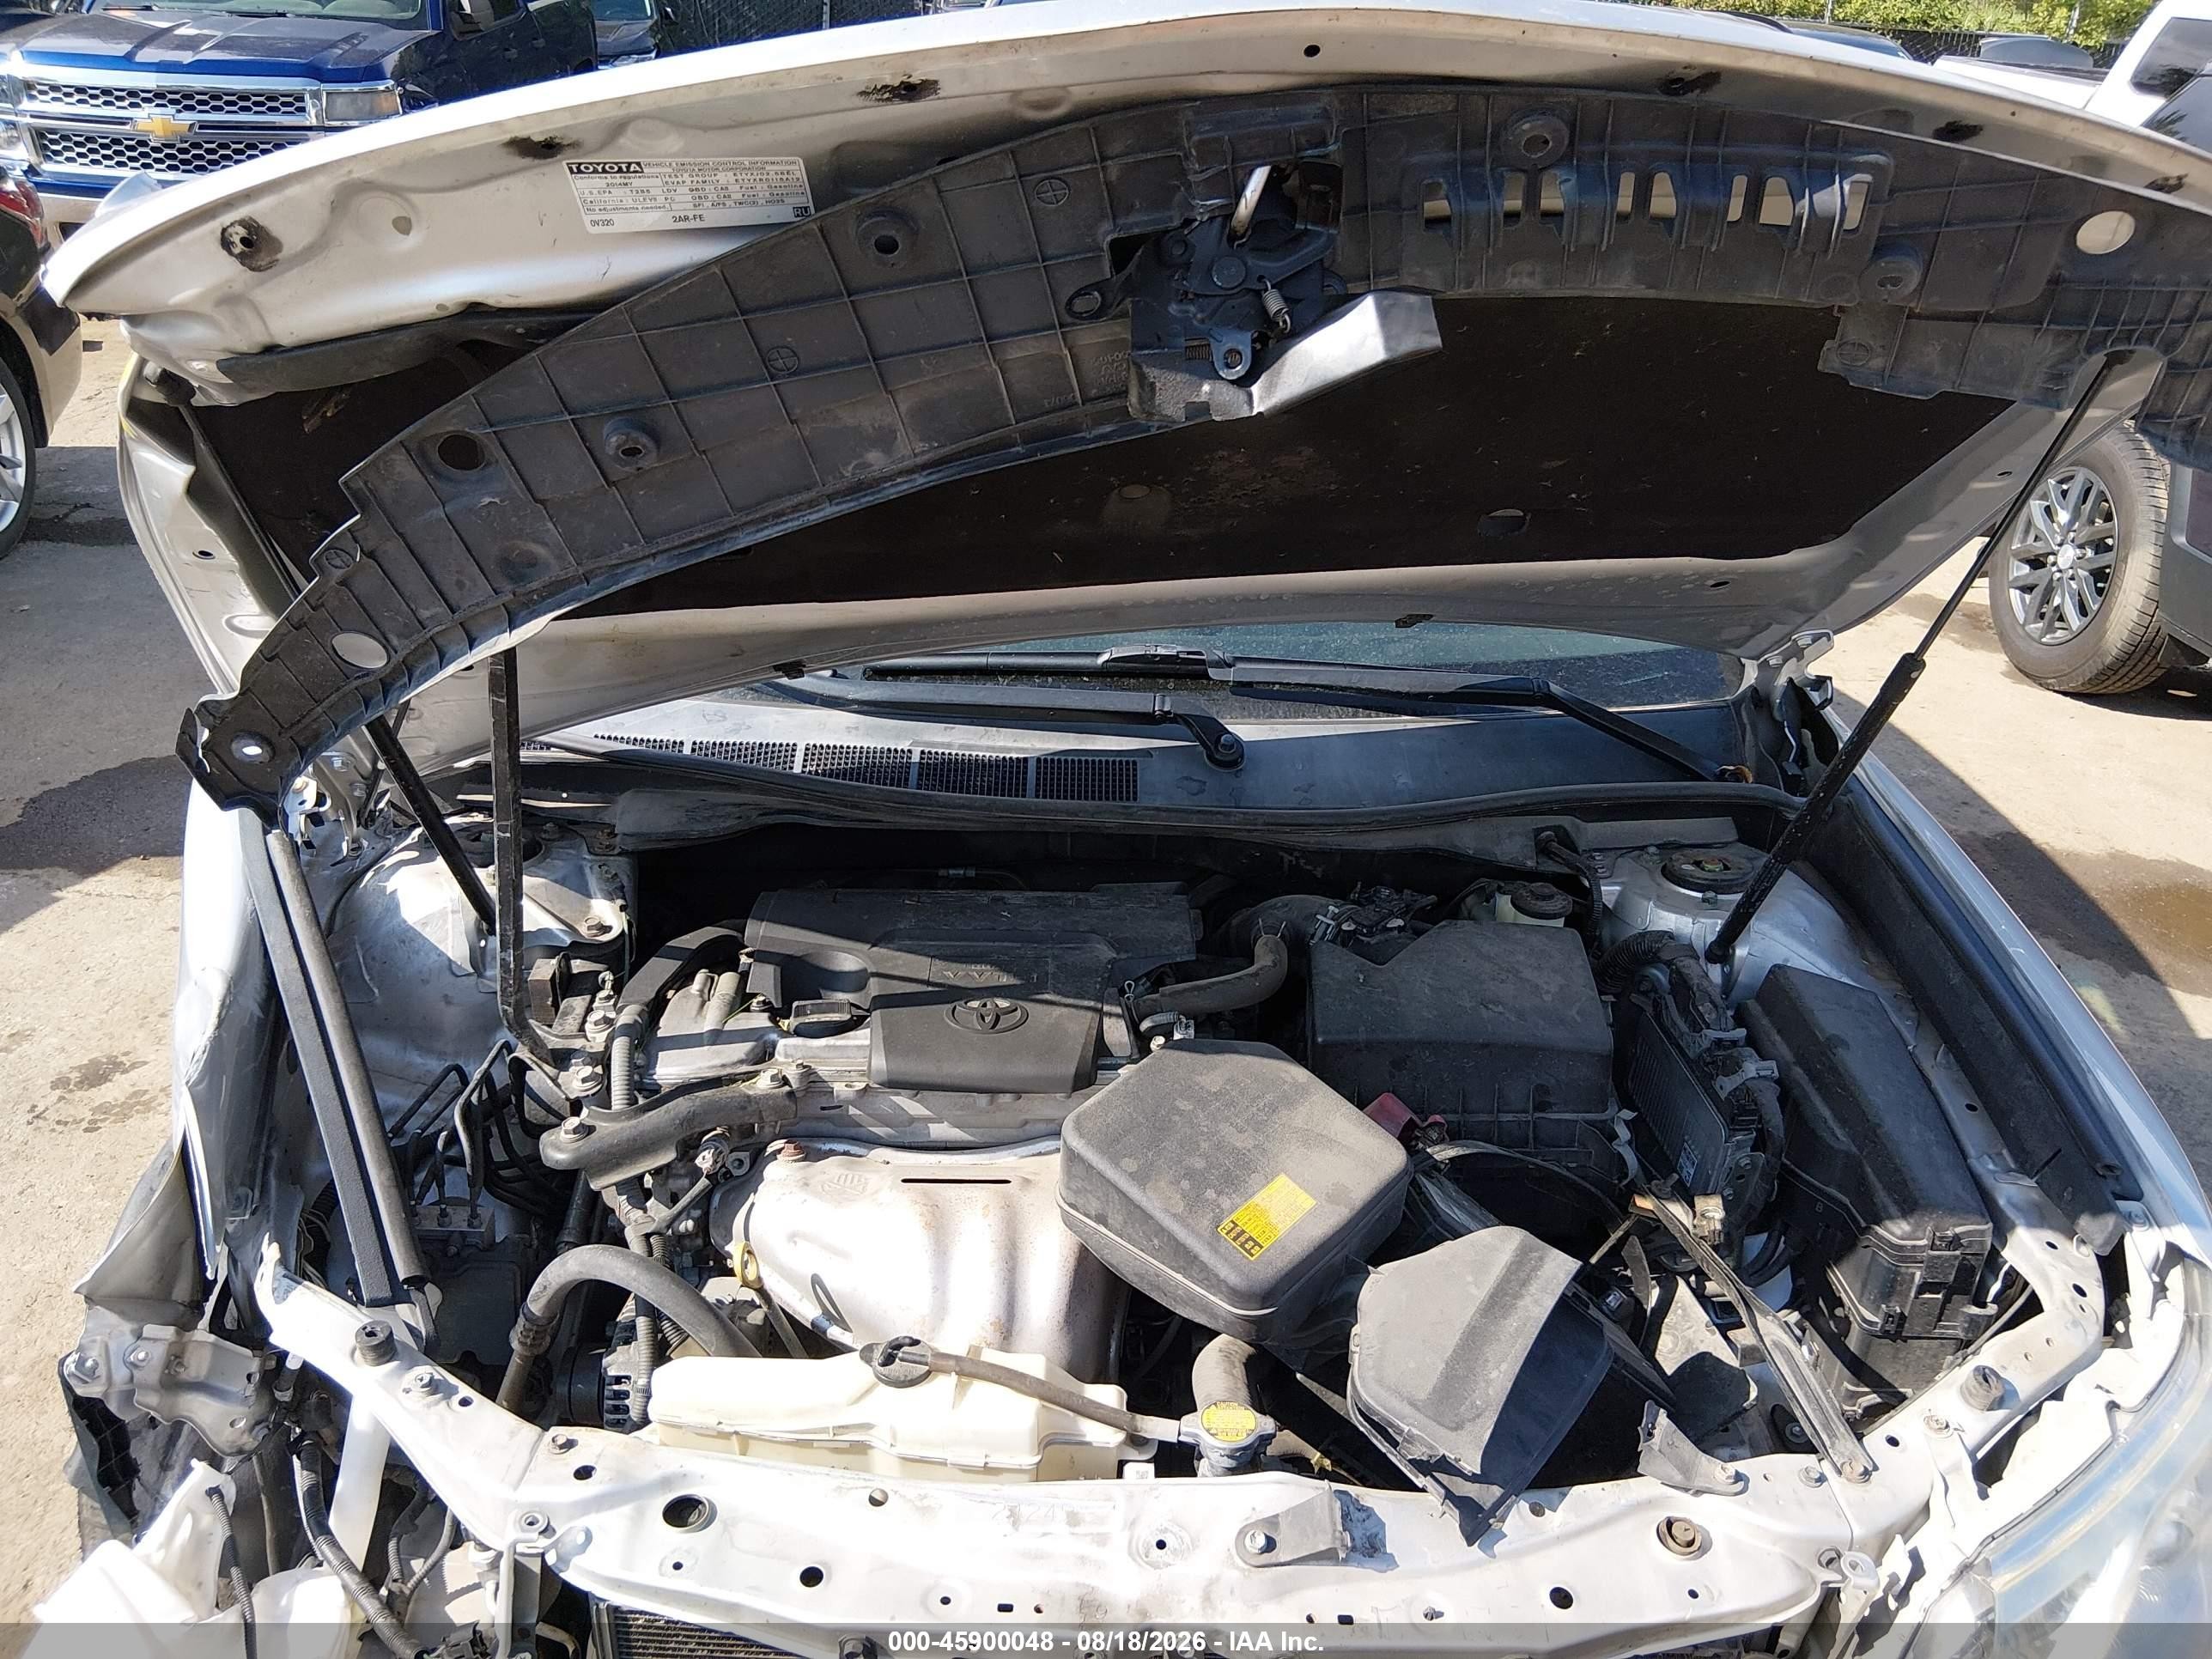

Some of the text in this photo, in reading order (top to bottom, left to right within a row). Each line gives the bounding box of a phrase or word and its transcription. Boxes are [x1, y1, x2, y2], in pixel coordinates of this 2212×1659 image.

[568, 163, 642, 173] TOYOTA
[793, 207, 811, 216] RU
[672, 214, 705, 223] 2AR-FE
